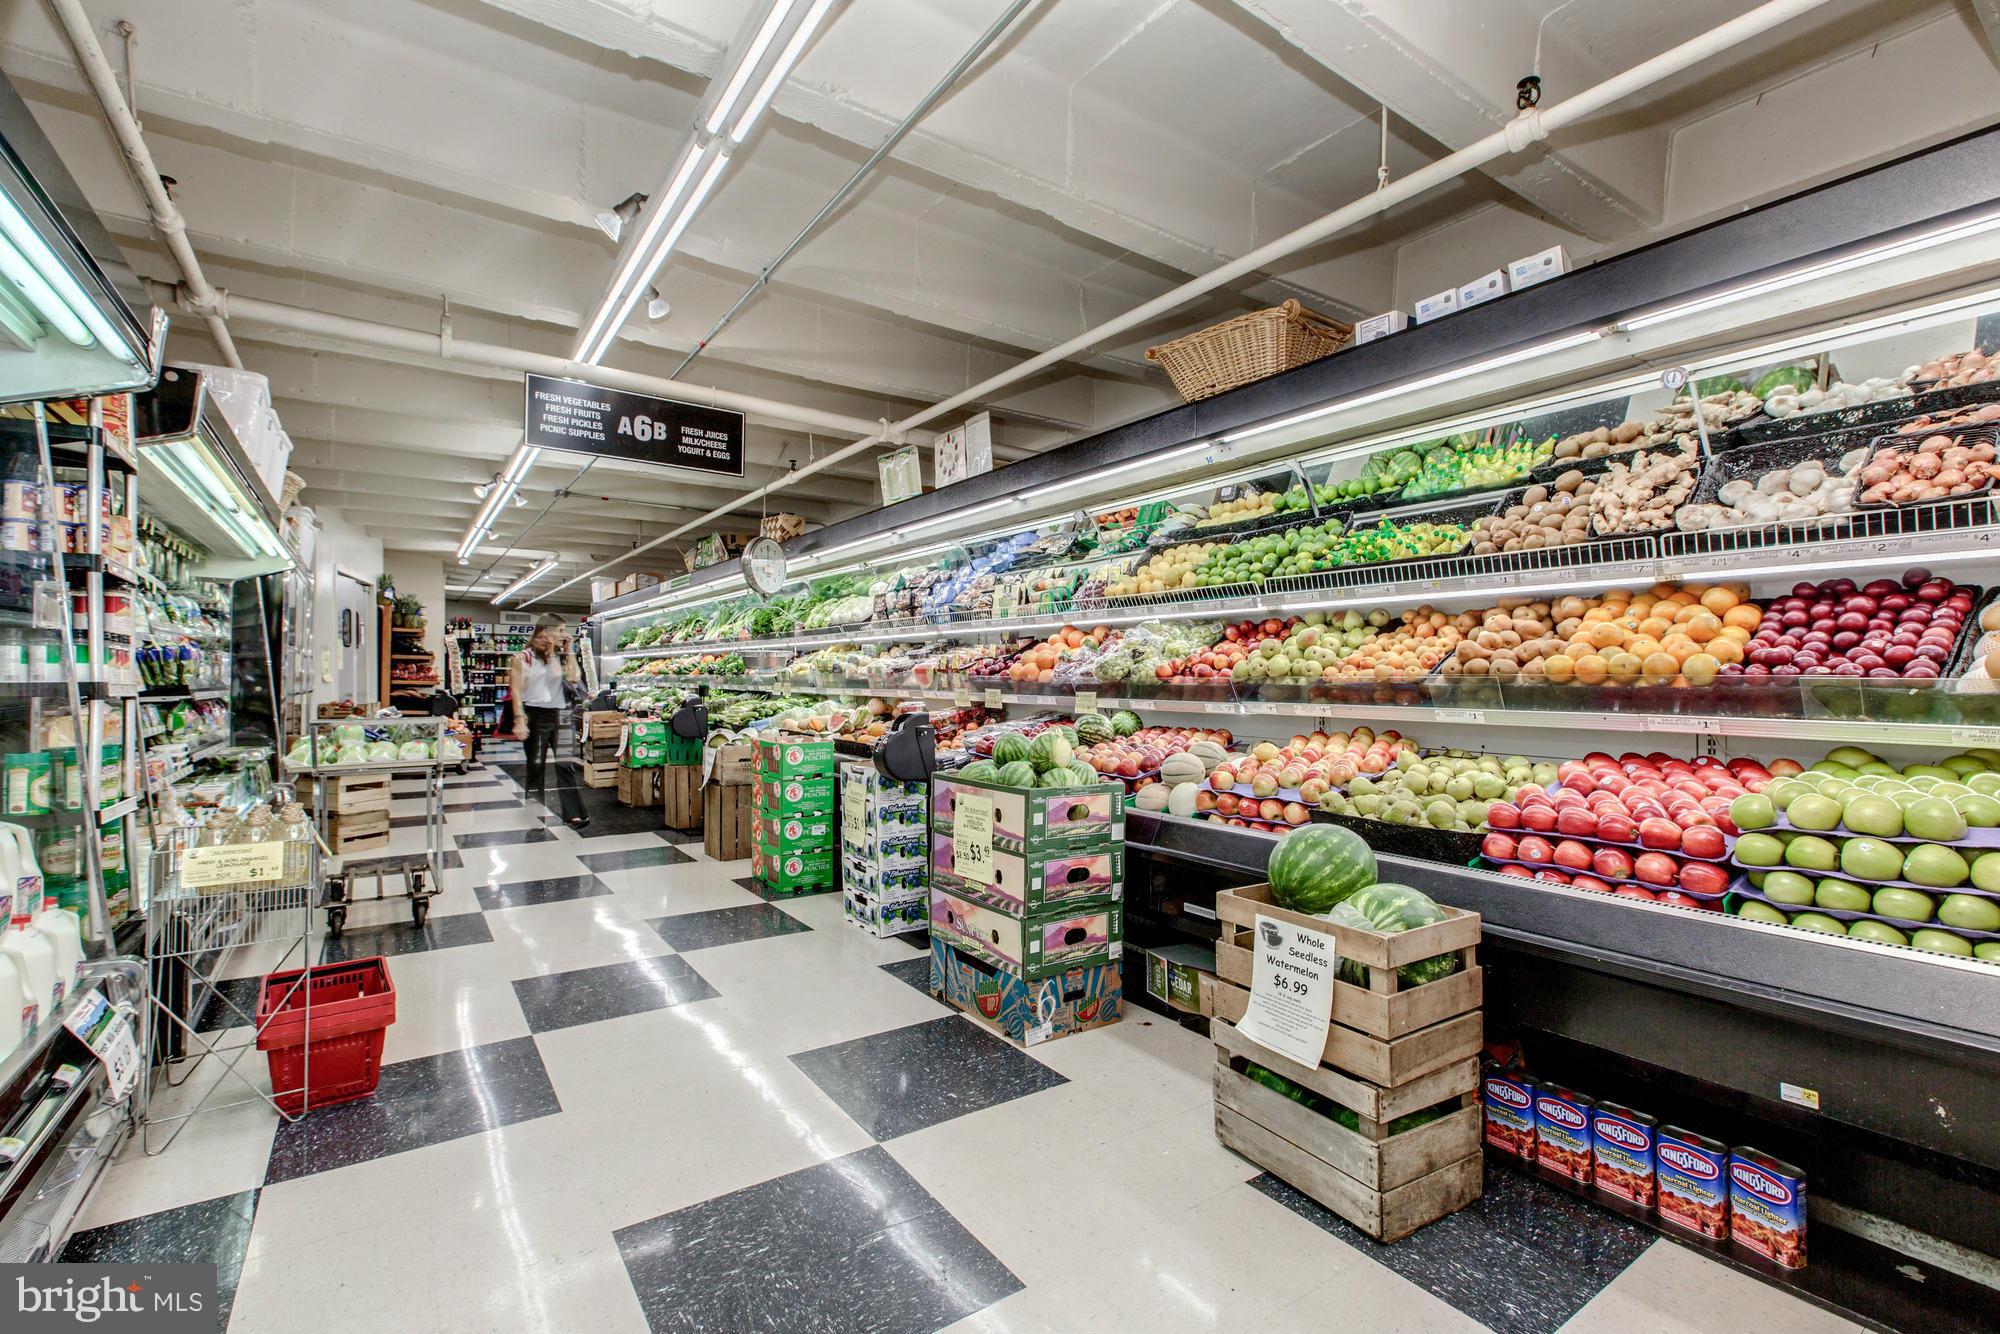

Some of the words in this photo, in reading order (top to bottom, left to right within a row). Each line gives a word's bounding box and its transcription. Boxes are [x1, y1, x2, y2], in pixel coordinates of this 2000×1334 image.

[535, 392, 562, 403] FRESH
[563, 397, 611, 411] VEGETABLES
[546, 404, 572, 415] FRESH
[573, 409, 601, 420] FRUITS
[540, 424, 567, 435] PICNIC
[568, 428, 605, 441] SUPPLIES
[543, 414, 569, 425] FRESH
[571, 418, 603, 430] PICKLES
[618, 415, 667, 441] A6B
[681, 426, 703, 437] FRESH
[705, 430, 728, 441] JUICES
[682, 436, 727, 450] MILK/CHEESE
[678, 444, 704, 456] YOGURT
[713, 450, 730, 460] EGGS
[1297, 932, 1325, 950] Whole
[1266, 954, 1319, 980] Watermelon
[1289, 947, 1328, 968] Seedless
[1273, 973, 1308, 996] $6.99
[1488, 1082, 1526, 1104] KINGSFORD
[1540, 1101, 1582, 1125] KINGSFORD
[1597, 1121, 1644, 1146] KINGSFORD
[1595, 1146, 1622, 1160] Charcoal
[1623, 1155, 1647, 1170] Lighter
[1660, 1148, 1713, 1174] KINGSFORD
[1659, 1172, 1688, 1187] Charcoal
[1689, 1183, 1715, 1199] Lighter
[1733, 1167, 1785, 1199] KINGSFORD
[1732, 1194, 1760, 1213] Charcoal
[1761, 1207, 1788, 1225] Lighter
